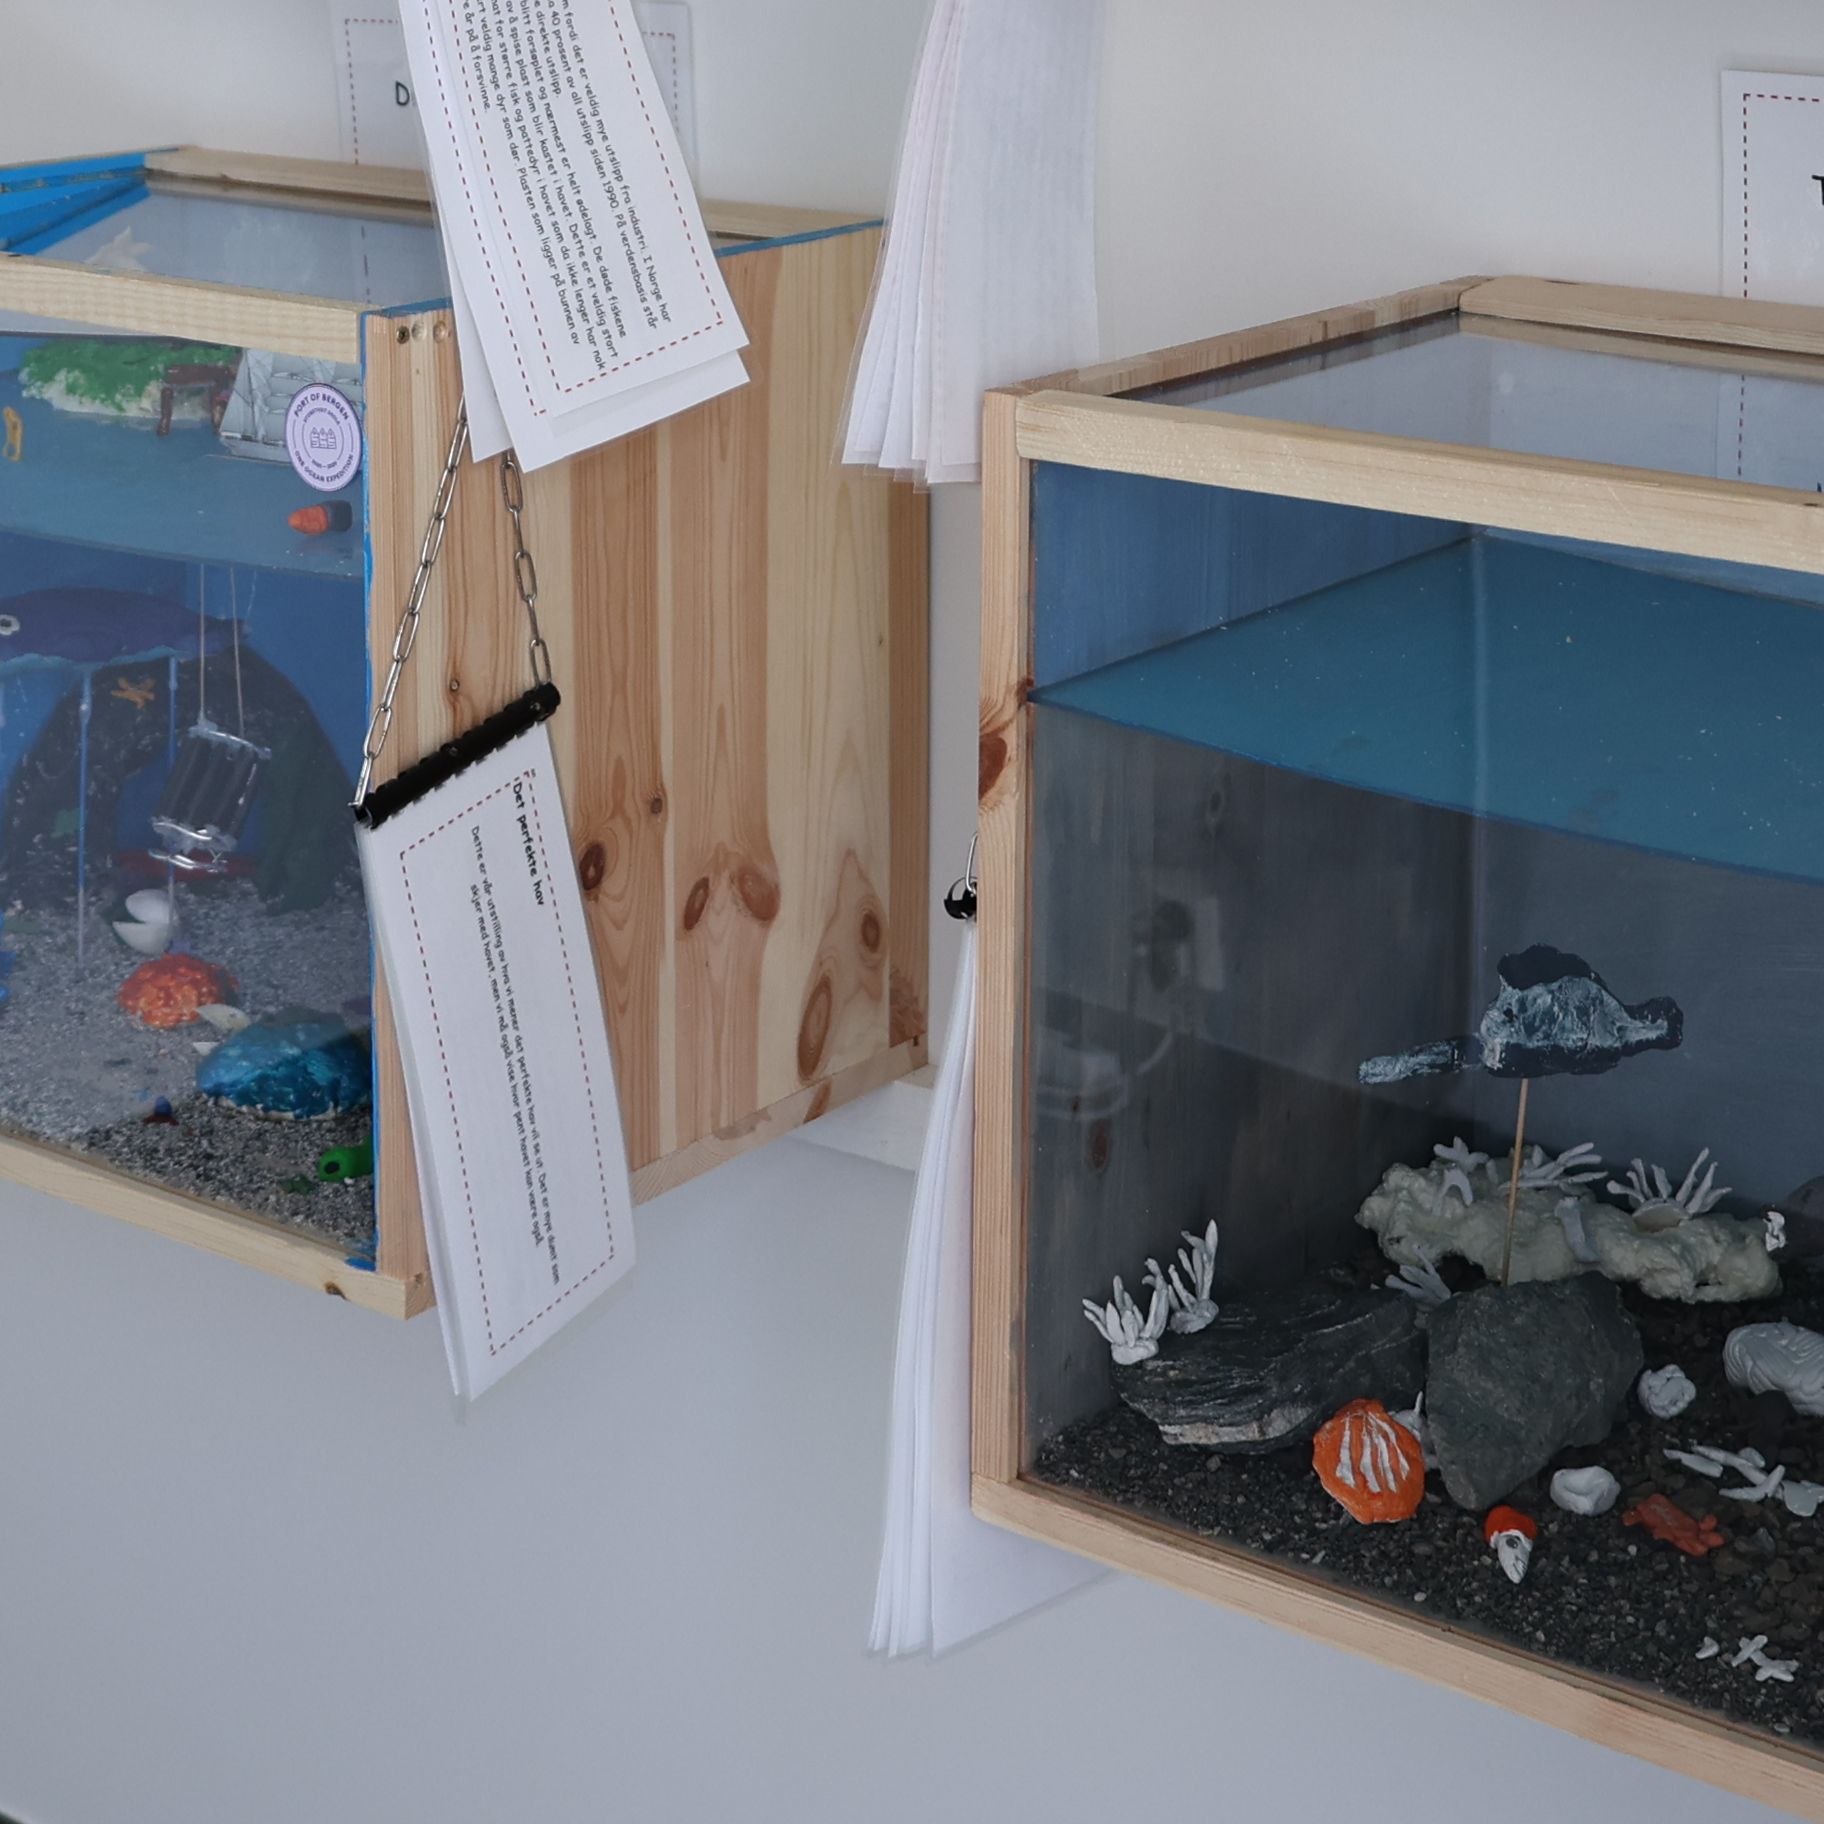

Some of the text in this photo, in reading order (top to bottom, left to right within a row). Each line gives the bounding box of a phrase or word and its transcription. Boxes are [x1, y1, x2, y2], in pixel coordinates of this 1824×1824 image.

[505, 0, 513, 12] av
[550, 10, 560, 26] 40
[494, 19, 504, 37] for
[509, 26, 521, 55] spise
[535, 10, 550, 53] direkte
[499, 42, 512, 79] større
[551, 28, 571, 71] prosent
[514, 58, 530, 86] plast
[566, 75, 575, 88] av
[507, 82, 520, 105] fisk
[524, 90, 536, 112] som
[571, 91, 582, 105] all
[513, 108, 523, 122] og
[532, 114, 543, 135] blir
[576, 107, 593, 145] utslipp
[516, 124, 540, 174] pattedyr
[538, 138, 557, 175] kastet
[590, 148, 606, 178] siden
[564, 11, 578, 41] fordi
[572, 44, 584, 63] det
[579, 67, 588, 79] er
[584, 82, 599, 116] veldig
[595, 118, 608, 141] mye
[605, 144, 623, 182] utslipp
[619, 185, 631, 204] fra
[645, 264, 662, 301] Norge
[658, 302, 671, 322] har
[525, 29, 543, 81] forsøplet
[537, 86, 547, 100] og
[543, 102, 565, 152] nærmest
[561, 156, 570, 169] er
[566, 171, 580, 194] helt
[592, 245, 602, 262] De
[598, 265, 613, 293] døde
[607, 295, 626, 337] fiskene
[538, 184, 555, 216] havet
[550, 220, 563, 243] som
[614, 213, 626, 228] På
[560, 245, 570, 260] da
[568, 222, 585, 257] Dette
[565, 261, 578, 286] ikke
[581, 260, 590, 272] er
[620, 230, 647, 303] verdensbasis
[586, 276, 596, 288] et
[574, 287, 589, 323] lenger
[591, 292, 606, 326] veldig
[643, 306, 658, 328] står
[585, 326, 596, 346] har
[601, 328, 618, 357] stort
[592, 349, 605, 370] nok
[294, 396, 310, 417] PORT
[310, 392, 320, 401] OF
[321, 393, 350, 421] BERGEN
[513, 782, 544, 906] Det perfekte hav
